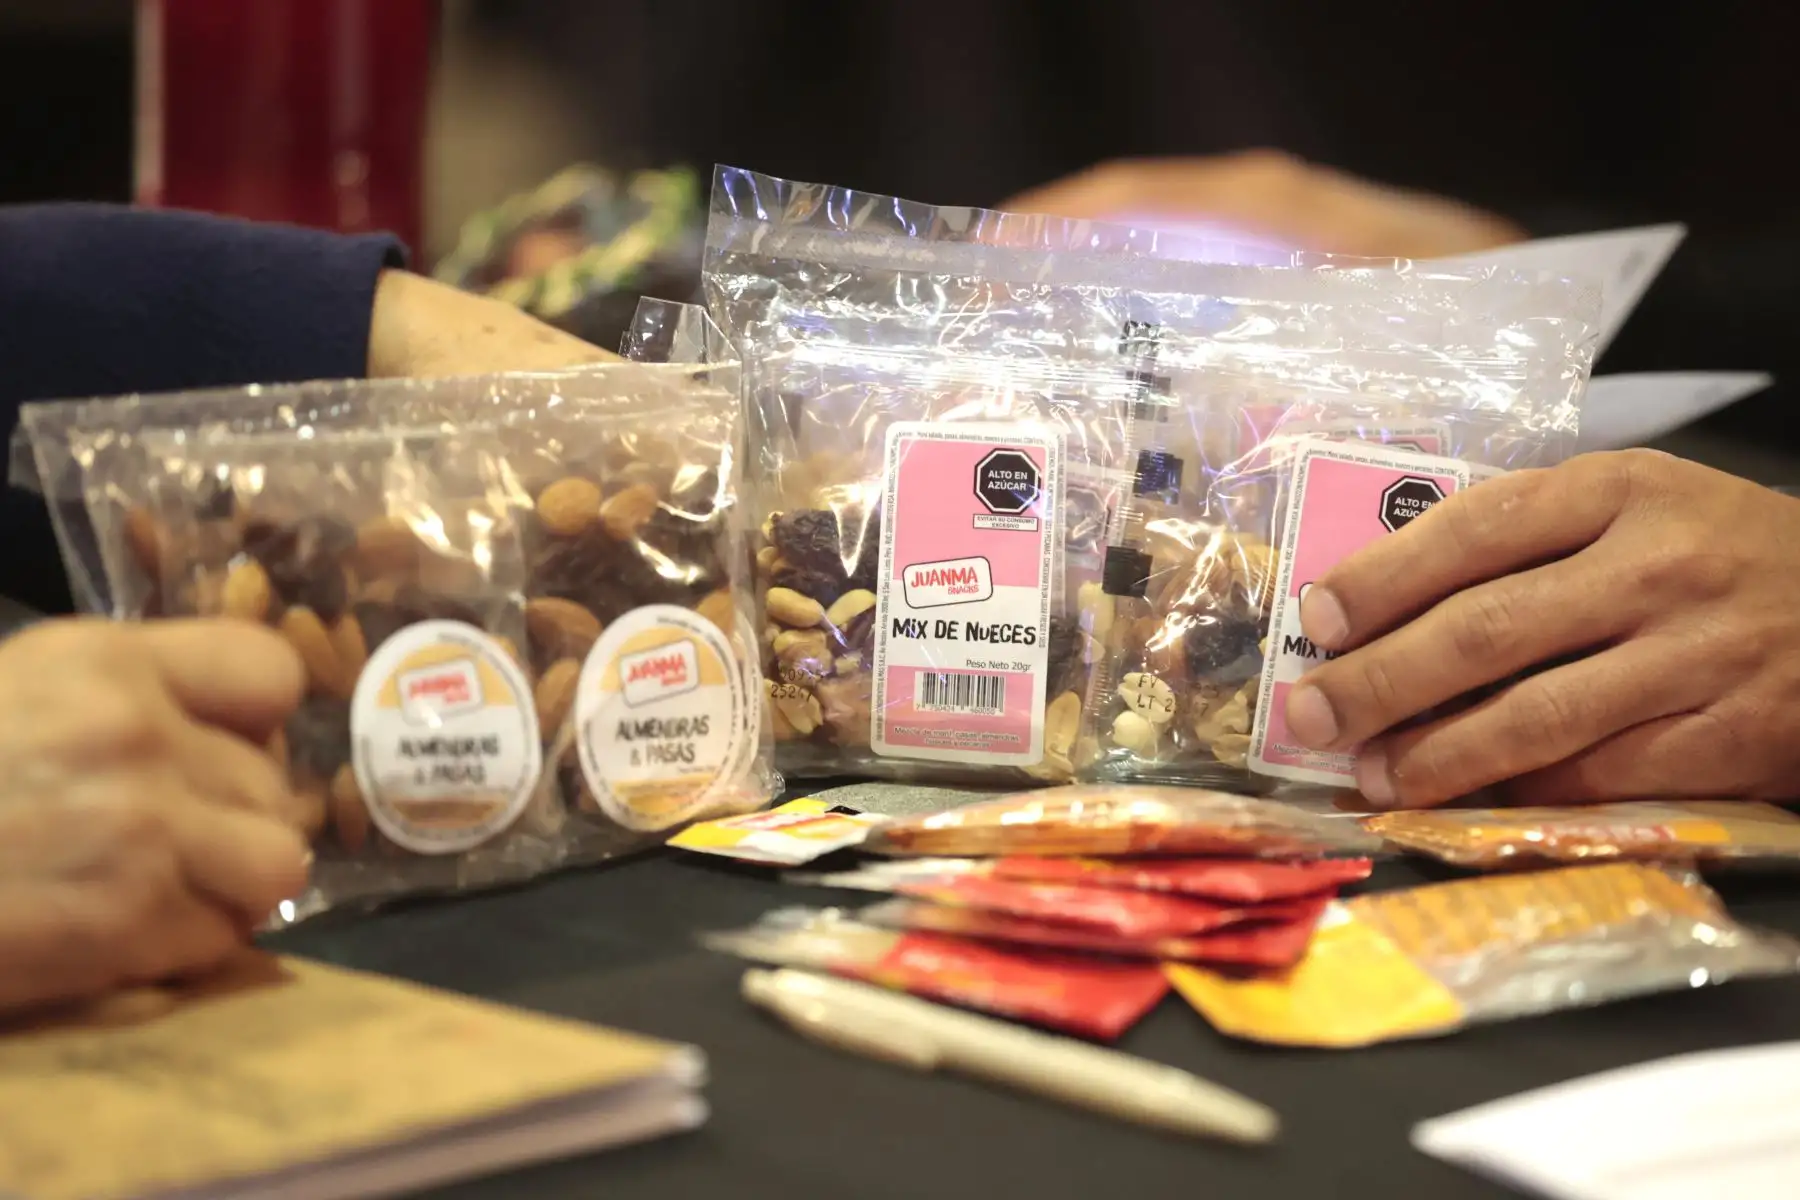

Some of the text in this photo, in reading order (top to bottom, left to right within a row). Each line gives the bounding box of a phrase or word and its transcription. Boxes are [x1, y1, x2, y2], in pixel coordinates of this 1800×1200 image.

[988, 470, 1028, 480] ALTO EN
[988, 480, 1027, 491] AZÚCAR
[1395, 496, 1420, 507] ALTO
[1393, 507, 1420, 518] AZÚC
[911, 566, 978, 588] JUANMA
[934, 620, 960, 641] DE
[965, 621, 1037, 646] NUECES
[966, 659, 1031, 673] Peso Neto 20gr
[616, 715, 710, 740] ALMENDRAS
[646, 742, 695, 764] PASAS
